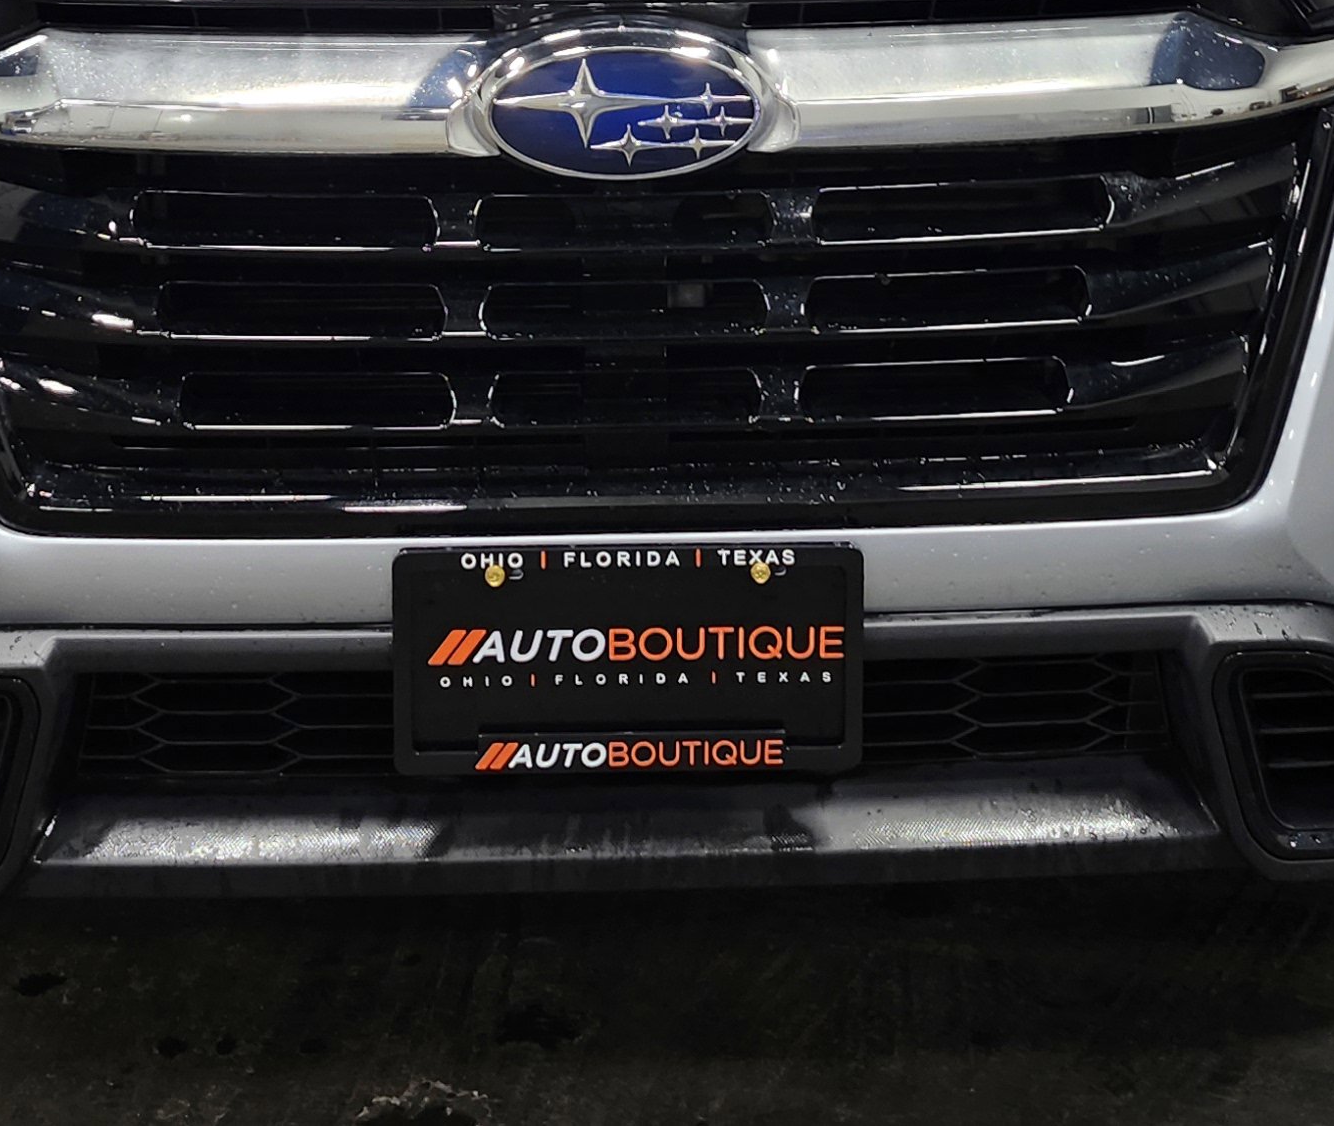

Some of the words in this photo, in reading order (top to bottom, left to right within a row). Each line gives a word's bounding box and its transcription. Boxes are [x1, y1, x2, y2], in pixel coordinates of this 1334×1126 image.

[460, 552, 524, 570] OHIO
[563, 550, 681, 568] FLORIDA
[716, 548, 796, 566] TEXAS
[473, 625, 845, 664] AUTOBOUTIQUE
[439, 675, 513, 688] OHIO
[554, 672, 689, 686] FLORIDA
[735, 670, 832, 685] TEXAS
[507, 739, 785, 770] AUTOBOUTIQUE
